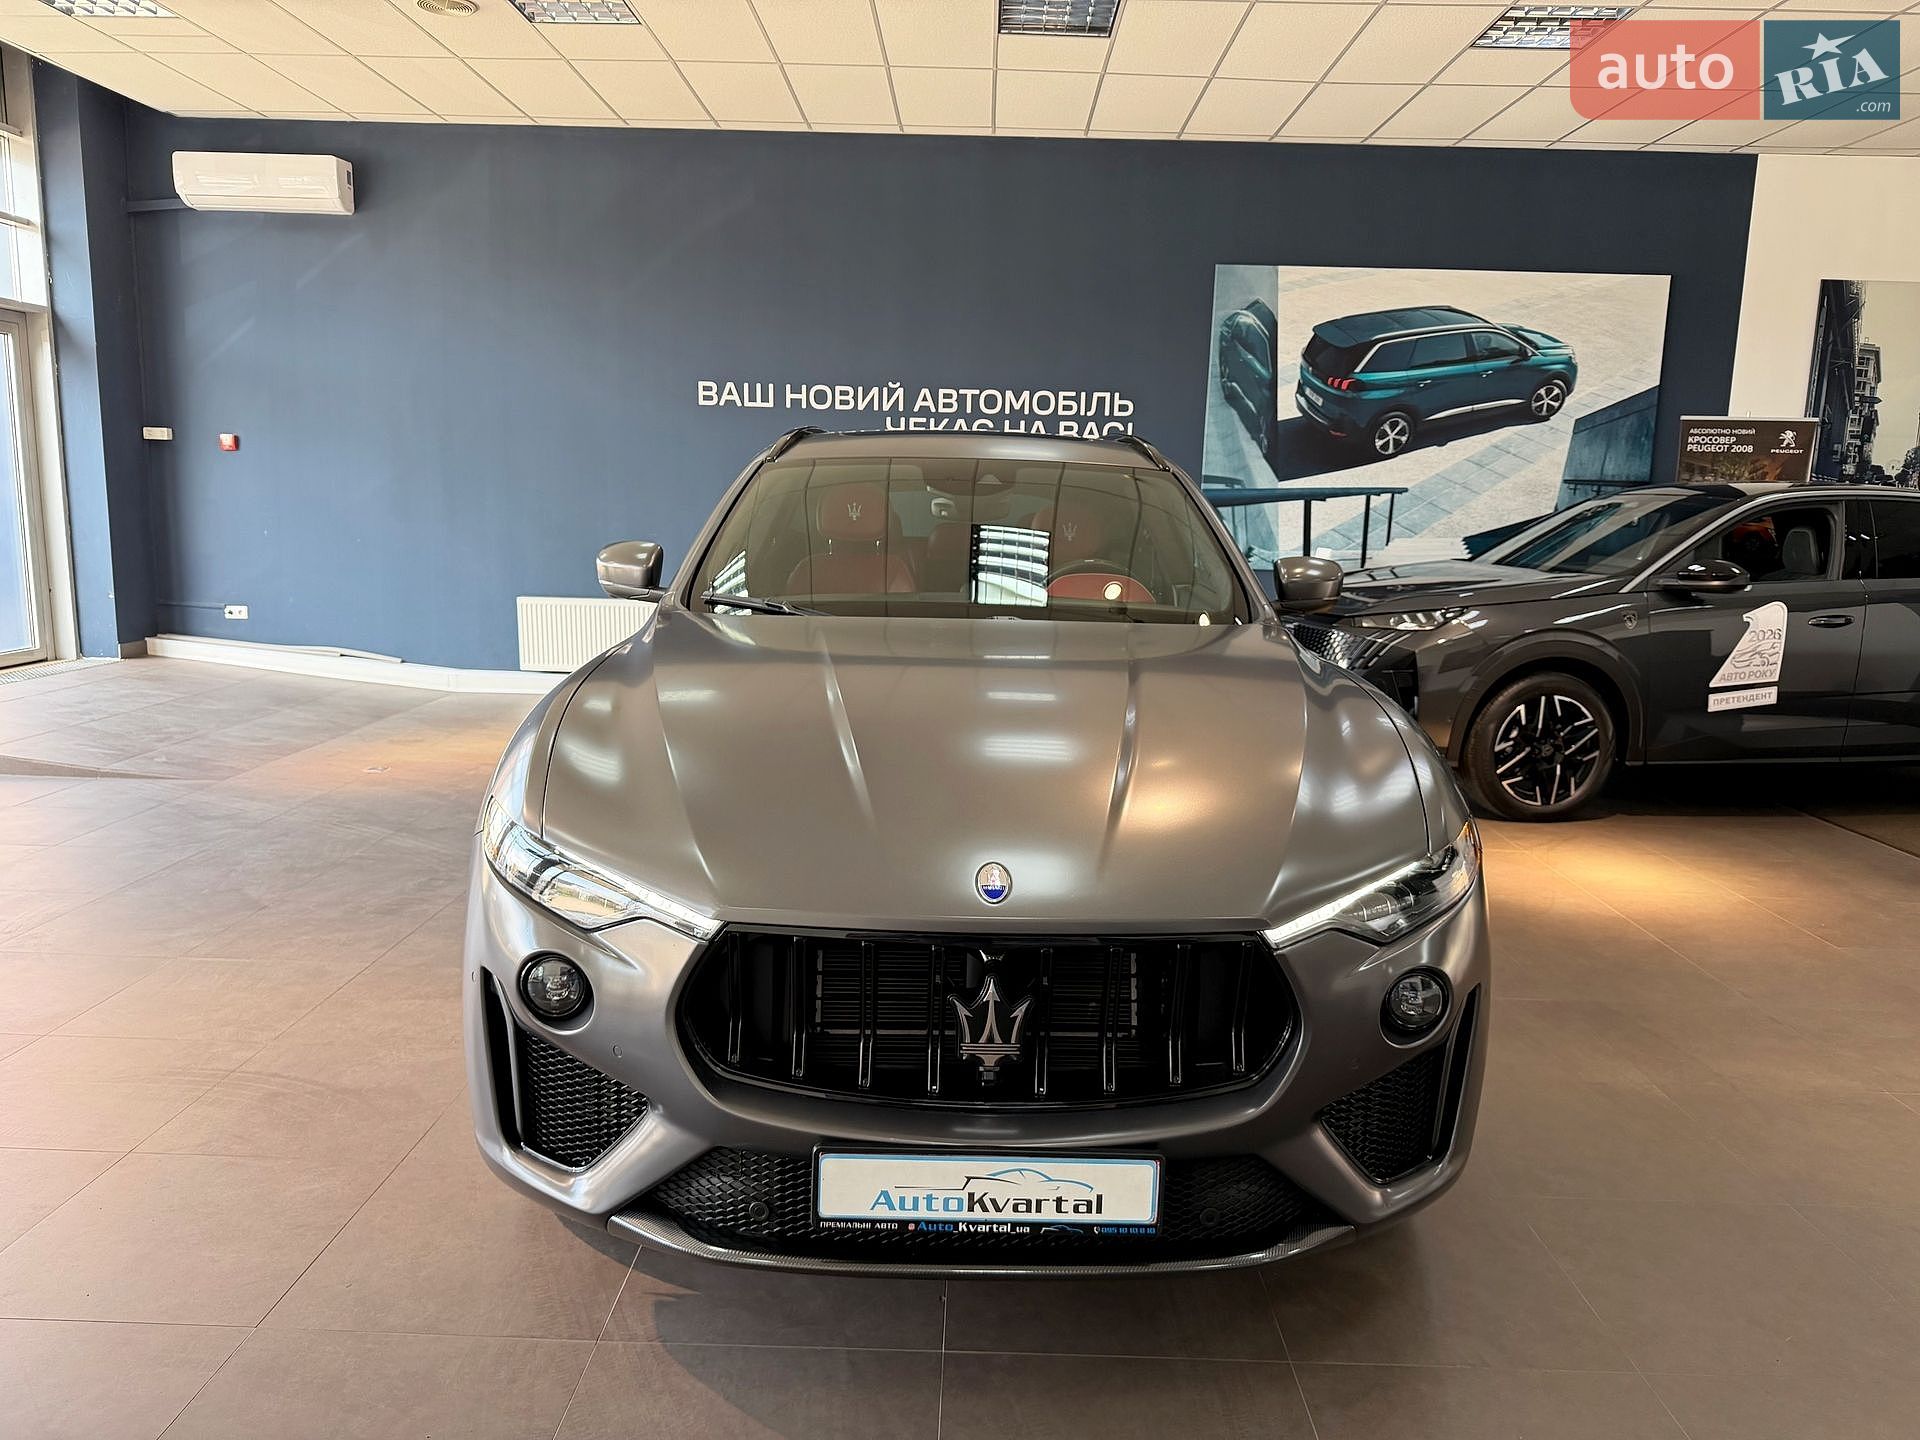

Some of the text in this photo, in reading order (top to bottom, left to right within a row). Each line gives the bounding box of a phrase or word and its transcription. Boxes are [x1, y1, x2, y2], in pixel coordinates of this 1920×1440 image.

[697, 380, 1135, 418] ВАШ НОВИЙ АВТОМОБІЛЬ
[1688, 436, 1736, 444] КРОСОВЕР
[1686, 444, 1754, 453] PEUGEOT 2008
[1749, 628, 1782, 642] 2026
[1719, 669, 1777, 682] АВТО РОКУ
[1713, 692, 1773, 705] ПРЕТЕНДЕНТ
[870, 1189, 1104, 1215] AutoKvartal
[819, 1221, 898, 1230] ПРЕМІАЛЬНІ АВТО
